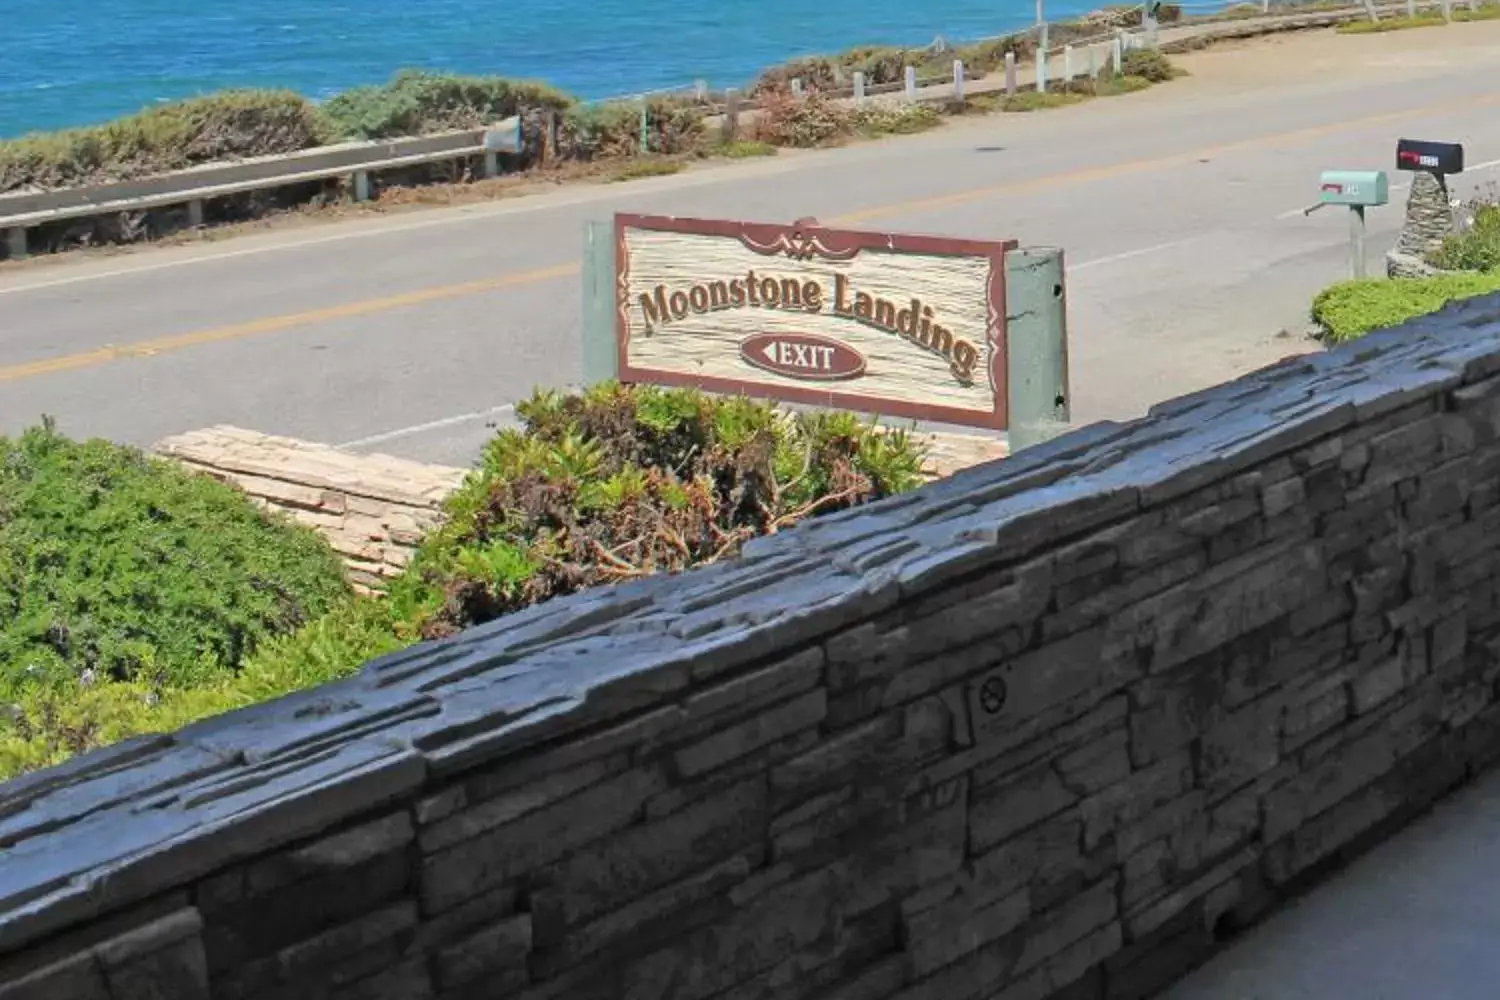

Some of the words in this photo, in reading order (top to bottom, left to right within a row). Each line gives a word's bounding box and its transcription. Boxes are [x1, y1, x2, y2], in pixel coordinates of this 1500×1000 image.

[641, 269, 823, 335] Moonstone
[833, 272, 979, 388] Landing
[779, 341, 835, 371] EXIT
